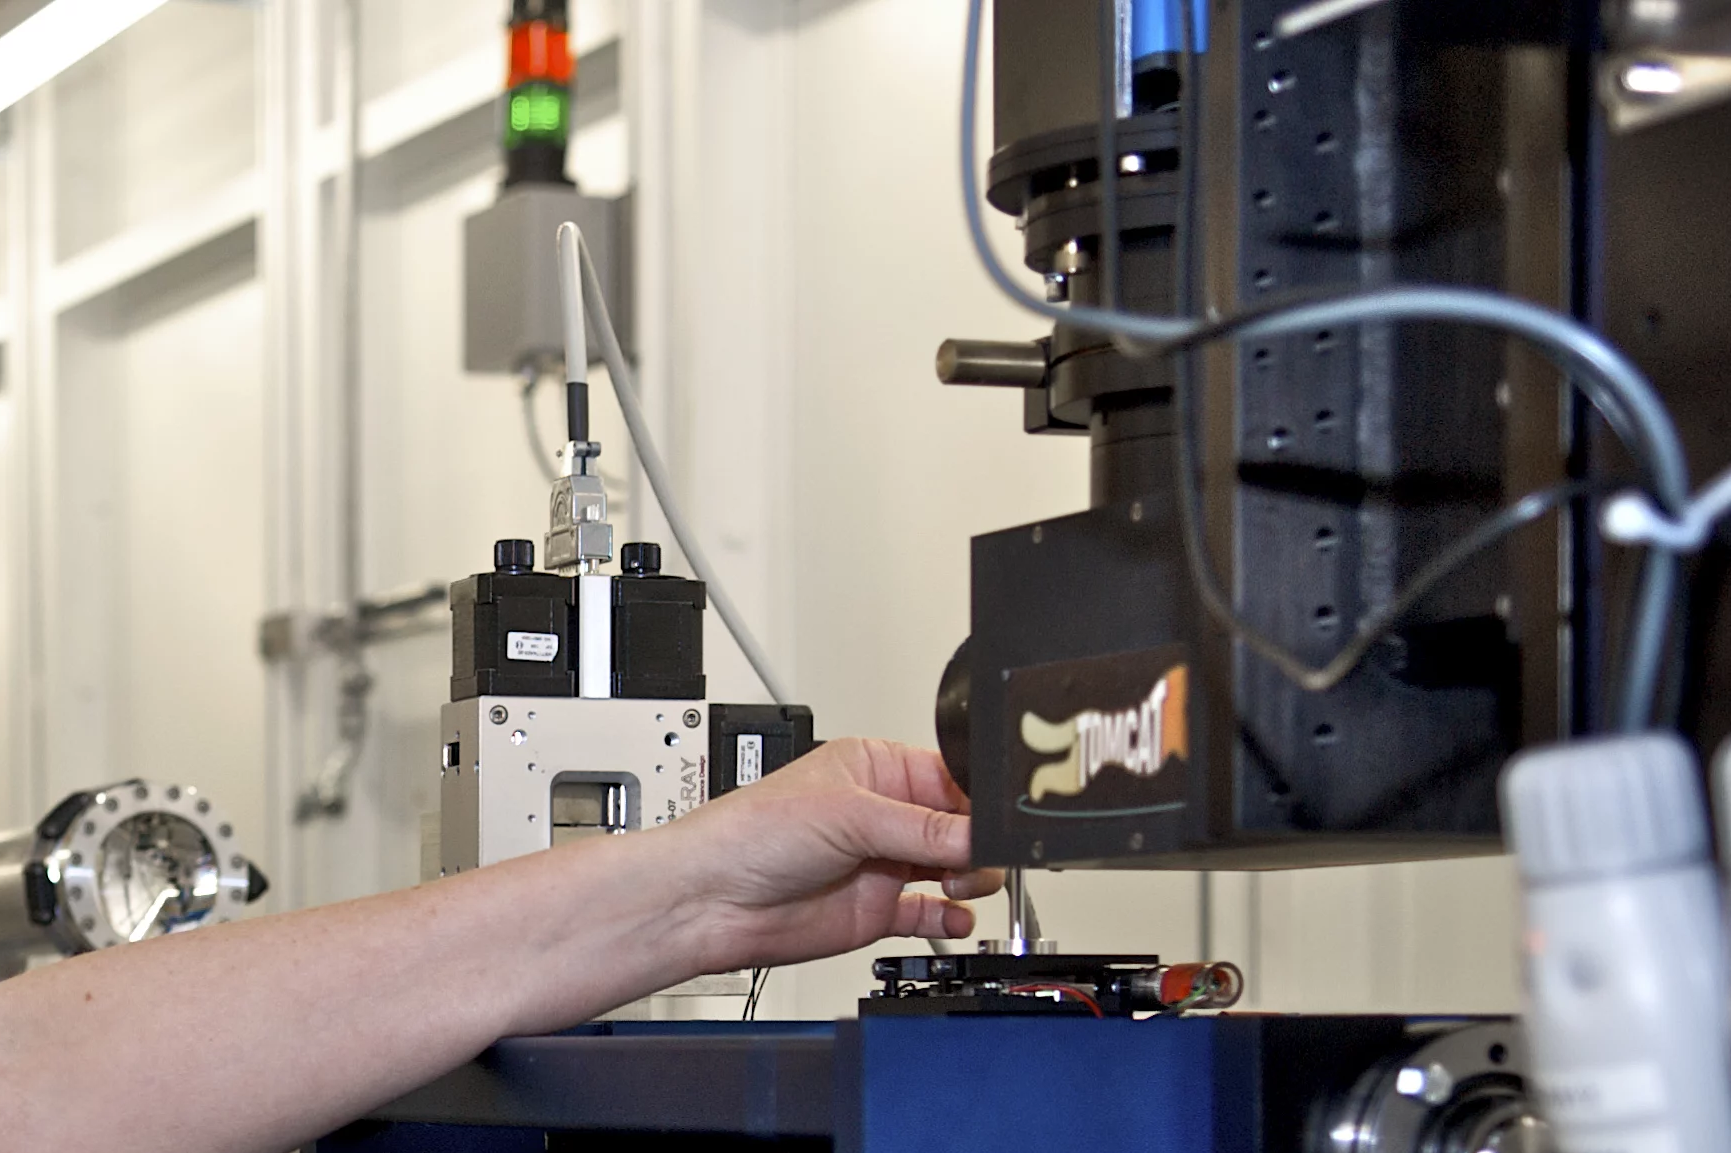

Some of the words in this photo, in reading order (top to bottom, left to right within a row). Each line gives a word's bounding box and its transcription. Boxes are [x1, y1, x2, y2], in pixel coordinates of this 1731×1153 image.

[1077, 678, 1168, 787] TOMCAT
[680, 756, 697, 814] -RAY
[698, 755, 706, 778] Design
